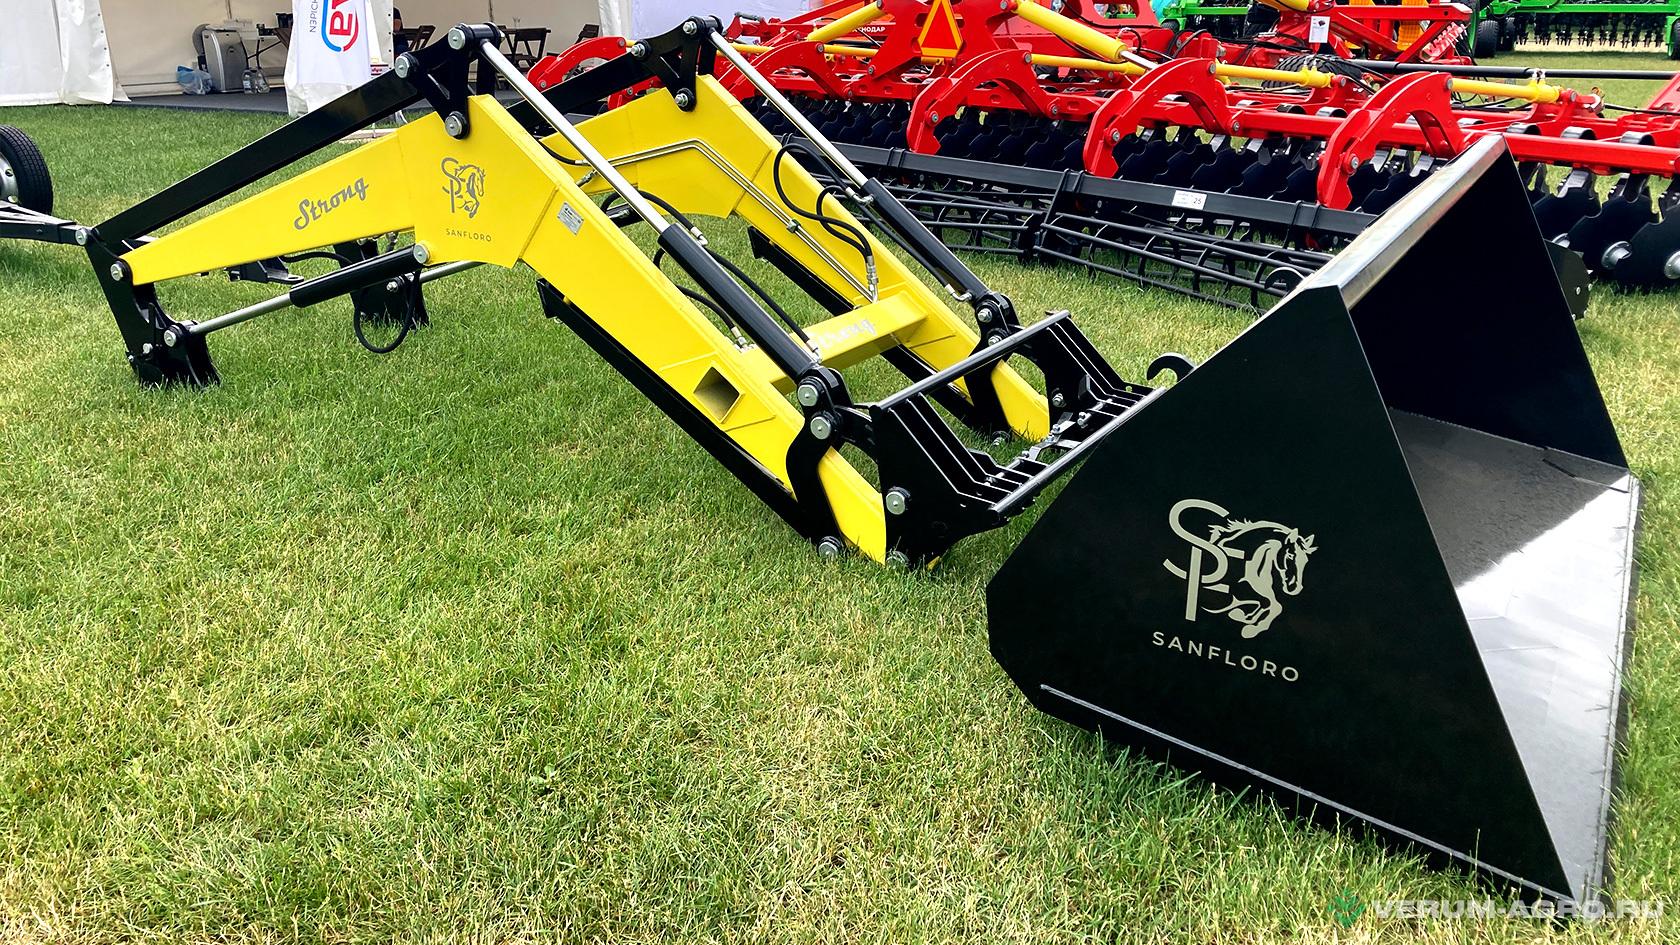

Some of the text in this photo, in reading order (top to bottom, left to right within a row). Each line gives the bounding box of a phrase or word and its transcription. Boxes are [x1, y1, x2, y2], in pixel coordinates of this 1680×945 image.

[294, 177, 370, 230] Strong
[445, 227, 492, 243] SANFLORO
[1152, 631, 1299, 682] SANFLORO
